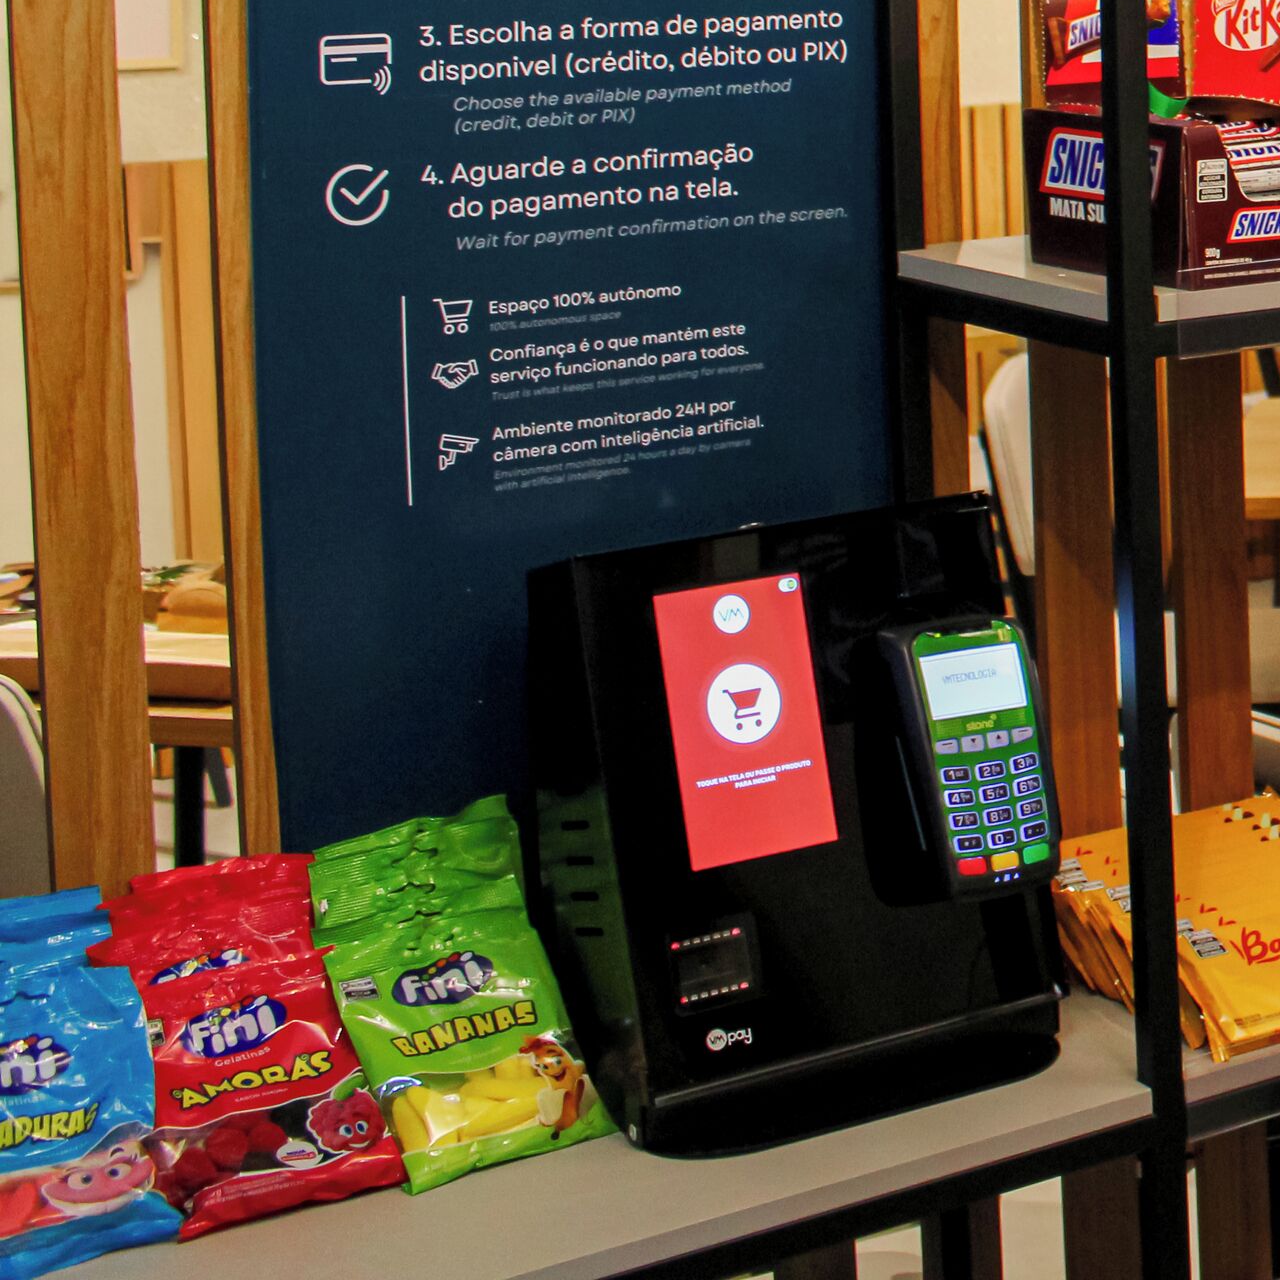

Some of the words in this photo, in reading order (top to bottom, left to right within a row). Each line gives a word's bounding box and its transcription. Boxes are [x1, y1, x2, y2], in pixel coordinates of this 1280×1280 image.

[419, 25, 441, 47] 3.
[449, 21, 551, 45] Escolha
[559, 25, 574, 40] a
[582, 17, 656, 39] forma
[666, 14, 697, 35] de
[704, 10, 843, 39] pagamento
[419, 54, 557, 86] disponivel
[565, 50, 674, 79] (crédito,
[681, 46, 761, 69] débito
[767, 46, 797, 63] ou
[803, 40, 847, 63] PIX)
[453, 96, 524, 112] Choose
[529, 92, 559, 108] the
[563, 87, 640, 105] available
[645, 83, 721, 103] payment
[726, 79, 792, 96] method
[454, 116, 521, 135] (credit,
[526, 112, 574, 129] debit
[578, 112, 597, 125] or
[602, 107, 636, 124] PIX)
[420, 165, 444, 185] 4.
[451, 157, 564, 187] Aguarde
[571, 158, 587, 174] a
[592, 143, 753, 174] confirmação
[448, 196, 483, 218] do
[490, 187, 642, 220] pagamento
[649, 184, 678, 202] na
[685, 176, 739, 200] tela.
[456, 234, 498, 250] Wait
[503, 231, 529, 247] for
[534, 226, 613, 247] payment
[618, 214, 729, 237] confirmation
[733, 213, 754, 225] on
[758, 210, 785, 224] the
[789, 206, 848, 223] screen.
[489, 297, 549, 316] Espaço
[553, 291, 595, 307] 100%
[599, 284, 681, 303] autônomo
[490, 340, 575, 362] Confiança
[580, 338, 590, 352] é
[594, 340, 604, 351] o
[608, 336, 638, 351] que
[642, 326, 708, 346] mantém
[712, 323, 746, 338] este
[490, 367, 551, 384] serviço
[555, 354, 657, 376] funcionando
[661, 349, 697, 367] para
[700, 344, 749, 360] todos.
[492, 421, 574, 441] Ambiente
[577, 407, 671, 429] monitorado
[675, 402, 705, 417] 24H
[709, 400, 736, 416] por
[493, 444, 557, 462] câmera
[560, 438, 597, 454] com
[601, 427, 693, 449] inteligência
[697, 415, 764, 436] artificial.
[966, 719, 995, 731] stone
[696, 778, 719, 789] TOQUE
[782, 760, 811, 773] PRODUTO
[392, 1001, 538, 1058] BANANAS
[728, 1027, 752, 1047] pay
[213, 1046, 271, 1068] Gelatinas
[179, 1050, 333, 1111] AMORAS
